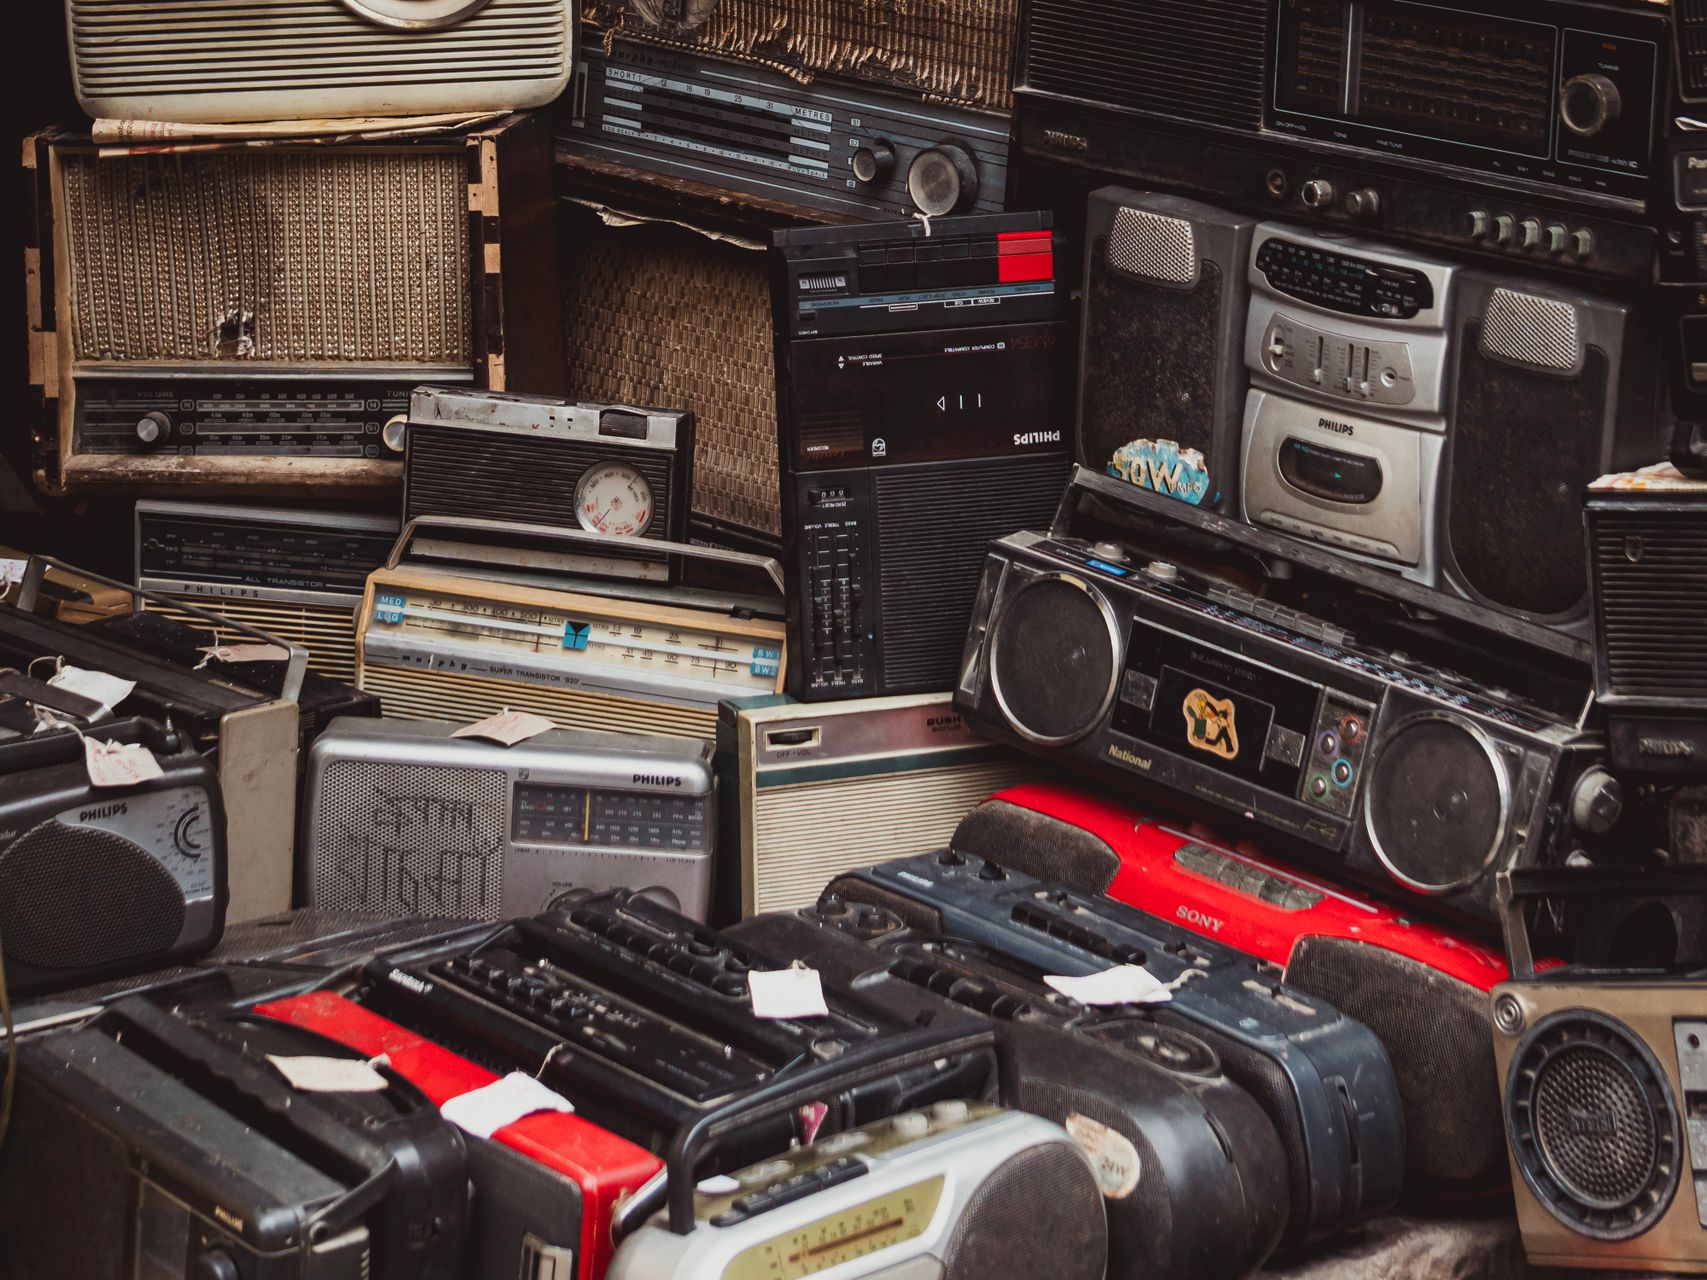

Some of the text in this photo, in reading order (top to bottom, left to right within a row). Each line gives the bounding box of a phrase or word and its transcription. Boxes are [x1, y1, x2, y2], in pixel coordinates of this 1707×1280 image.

[704, 88, 712, 97] 19
[734, 94, 743, 104] 25
[766, 101, 774, 110] 31
[794, 107, 832, 121] METRES
[793, 127, 830, 142] METRES
[137, 390, 175, 399] VOLUME
[1319, 418, 1354, 436] PHILIPS
[1013, 429, 1061, 446] PHILIPS
[244, 576, 324, 588] ALL TRANSISTOR
[183, 584, 259, 598] PHILIPS
[380, 596, 402, 606] MED
[490, 606, 509, 617] 400
[520, 610, 538, 620] 500
[669, 631, 680, 640] 25
[690, 656, 700, 664] 75
[724, 661, 737, 669] 90
[489, 665, 514, 676] SUPER
[516, 669, 561, 682] TRANSISTOR
[926, 715, 962, 726] BUSH
[776, 750, 811, 759] OFF VOL
[1108, 743, 1152, 771] National
[632, 774, 682, 787] PHILIPS
[80, 802, 128, 822] PHILIPS
[1175, 904, 1225, 934] SONY
